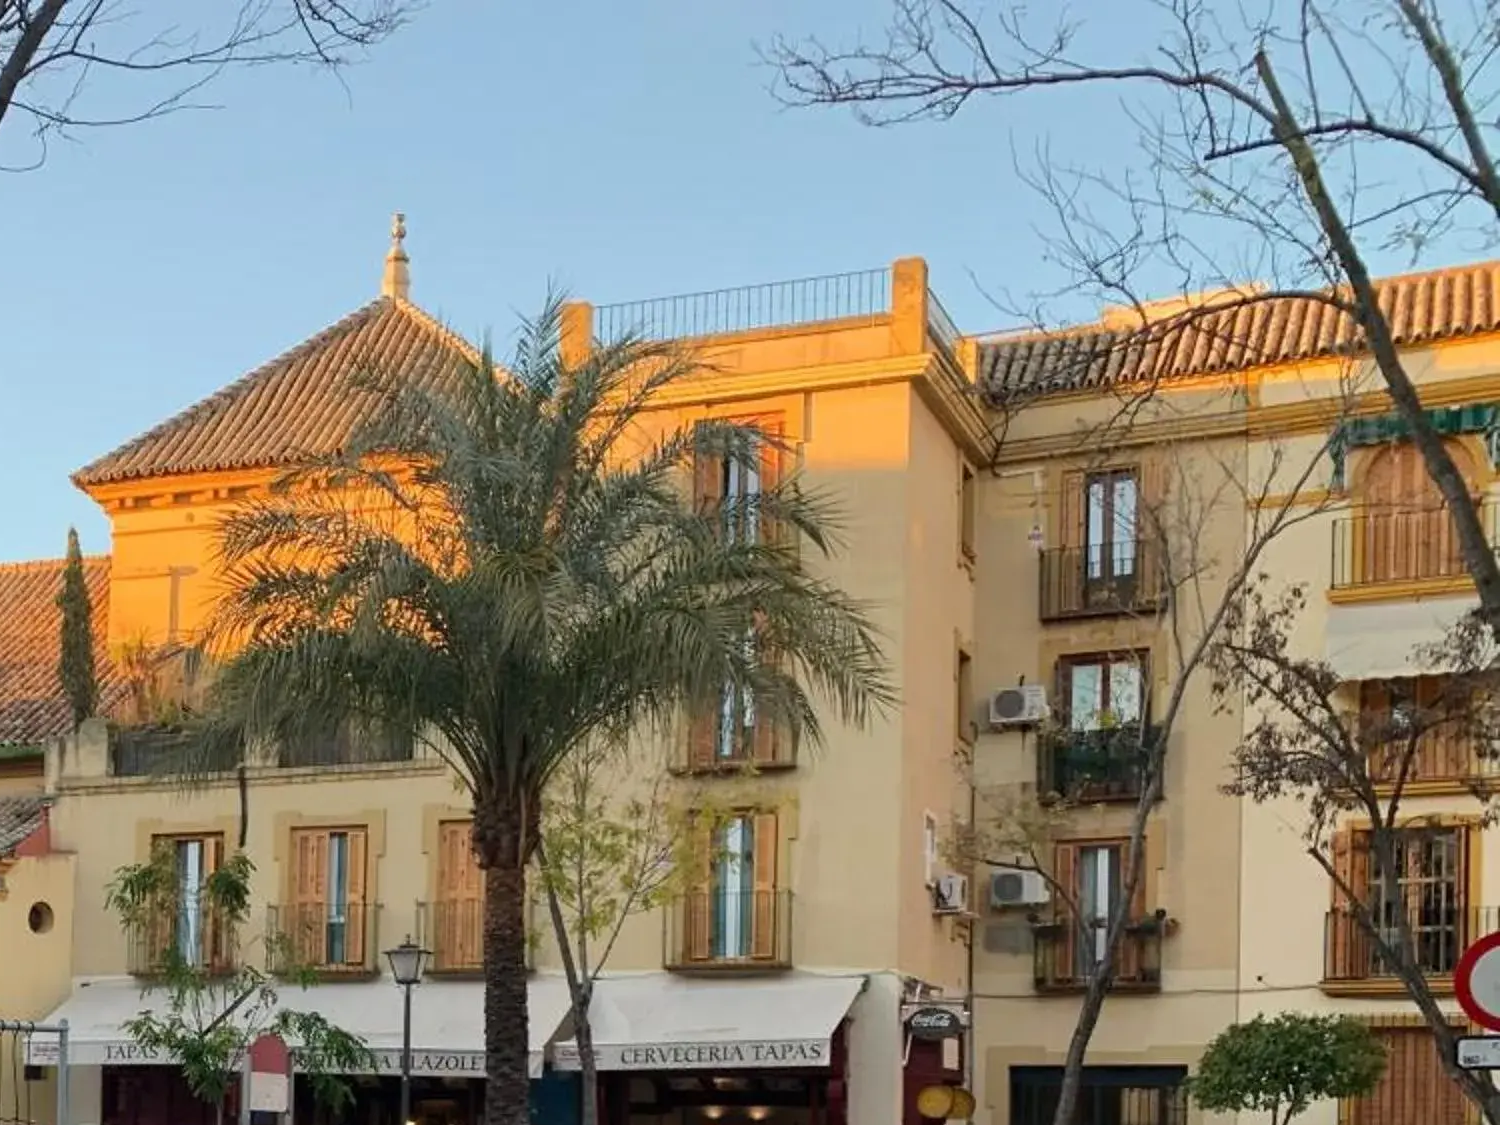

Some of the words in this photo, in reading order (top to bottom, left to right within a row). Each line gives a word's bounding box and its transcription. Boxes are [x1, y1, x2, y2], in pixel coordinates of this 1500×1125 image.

[104, 1044, 160, 1060] TAPAS
[751, 1042, 822, 1061] TAPAS
[400, 1055, 485, 1071] LAZOLE
